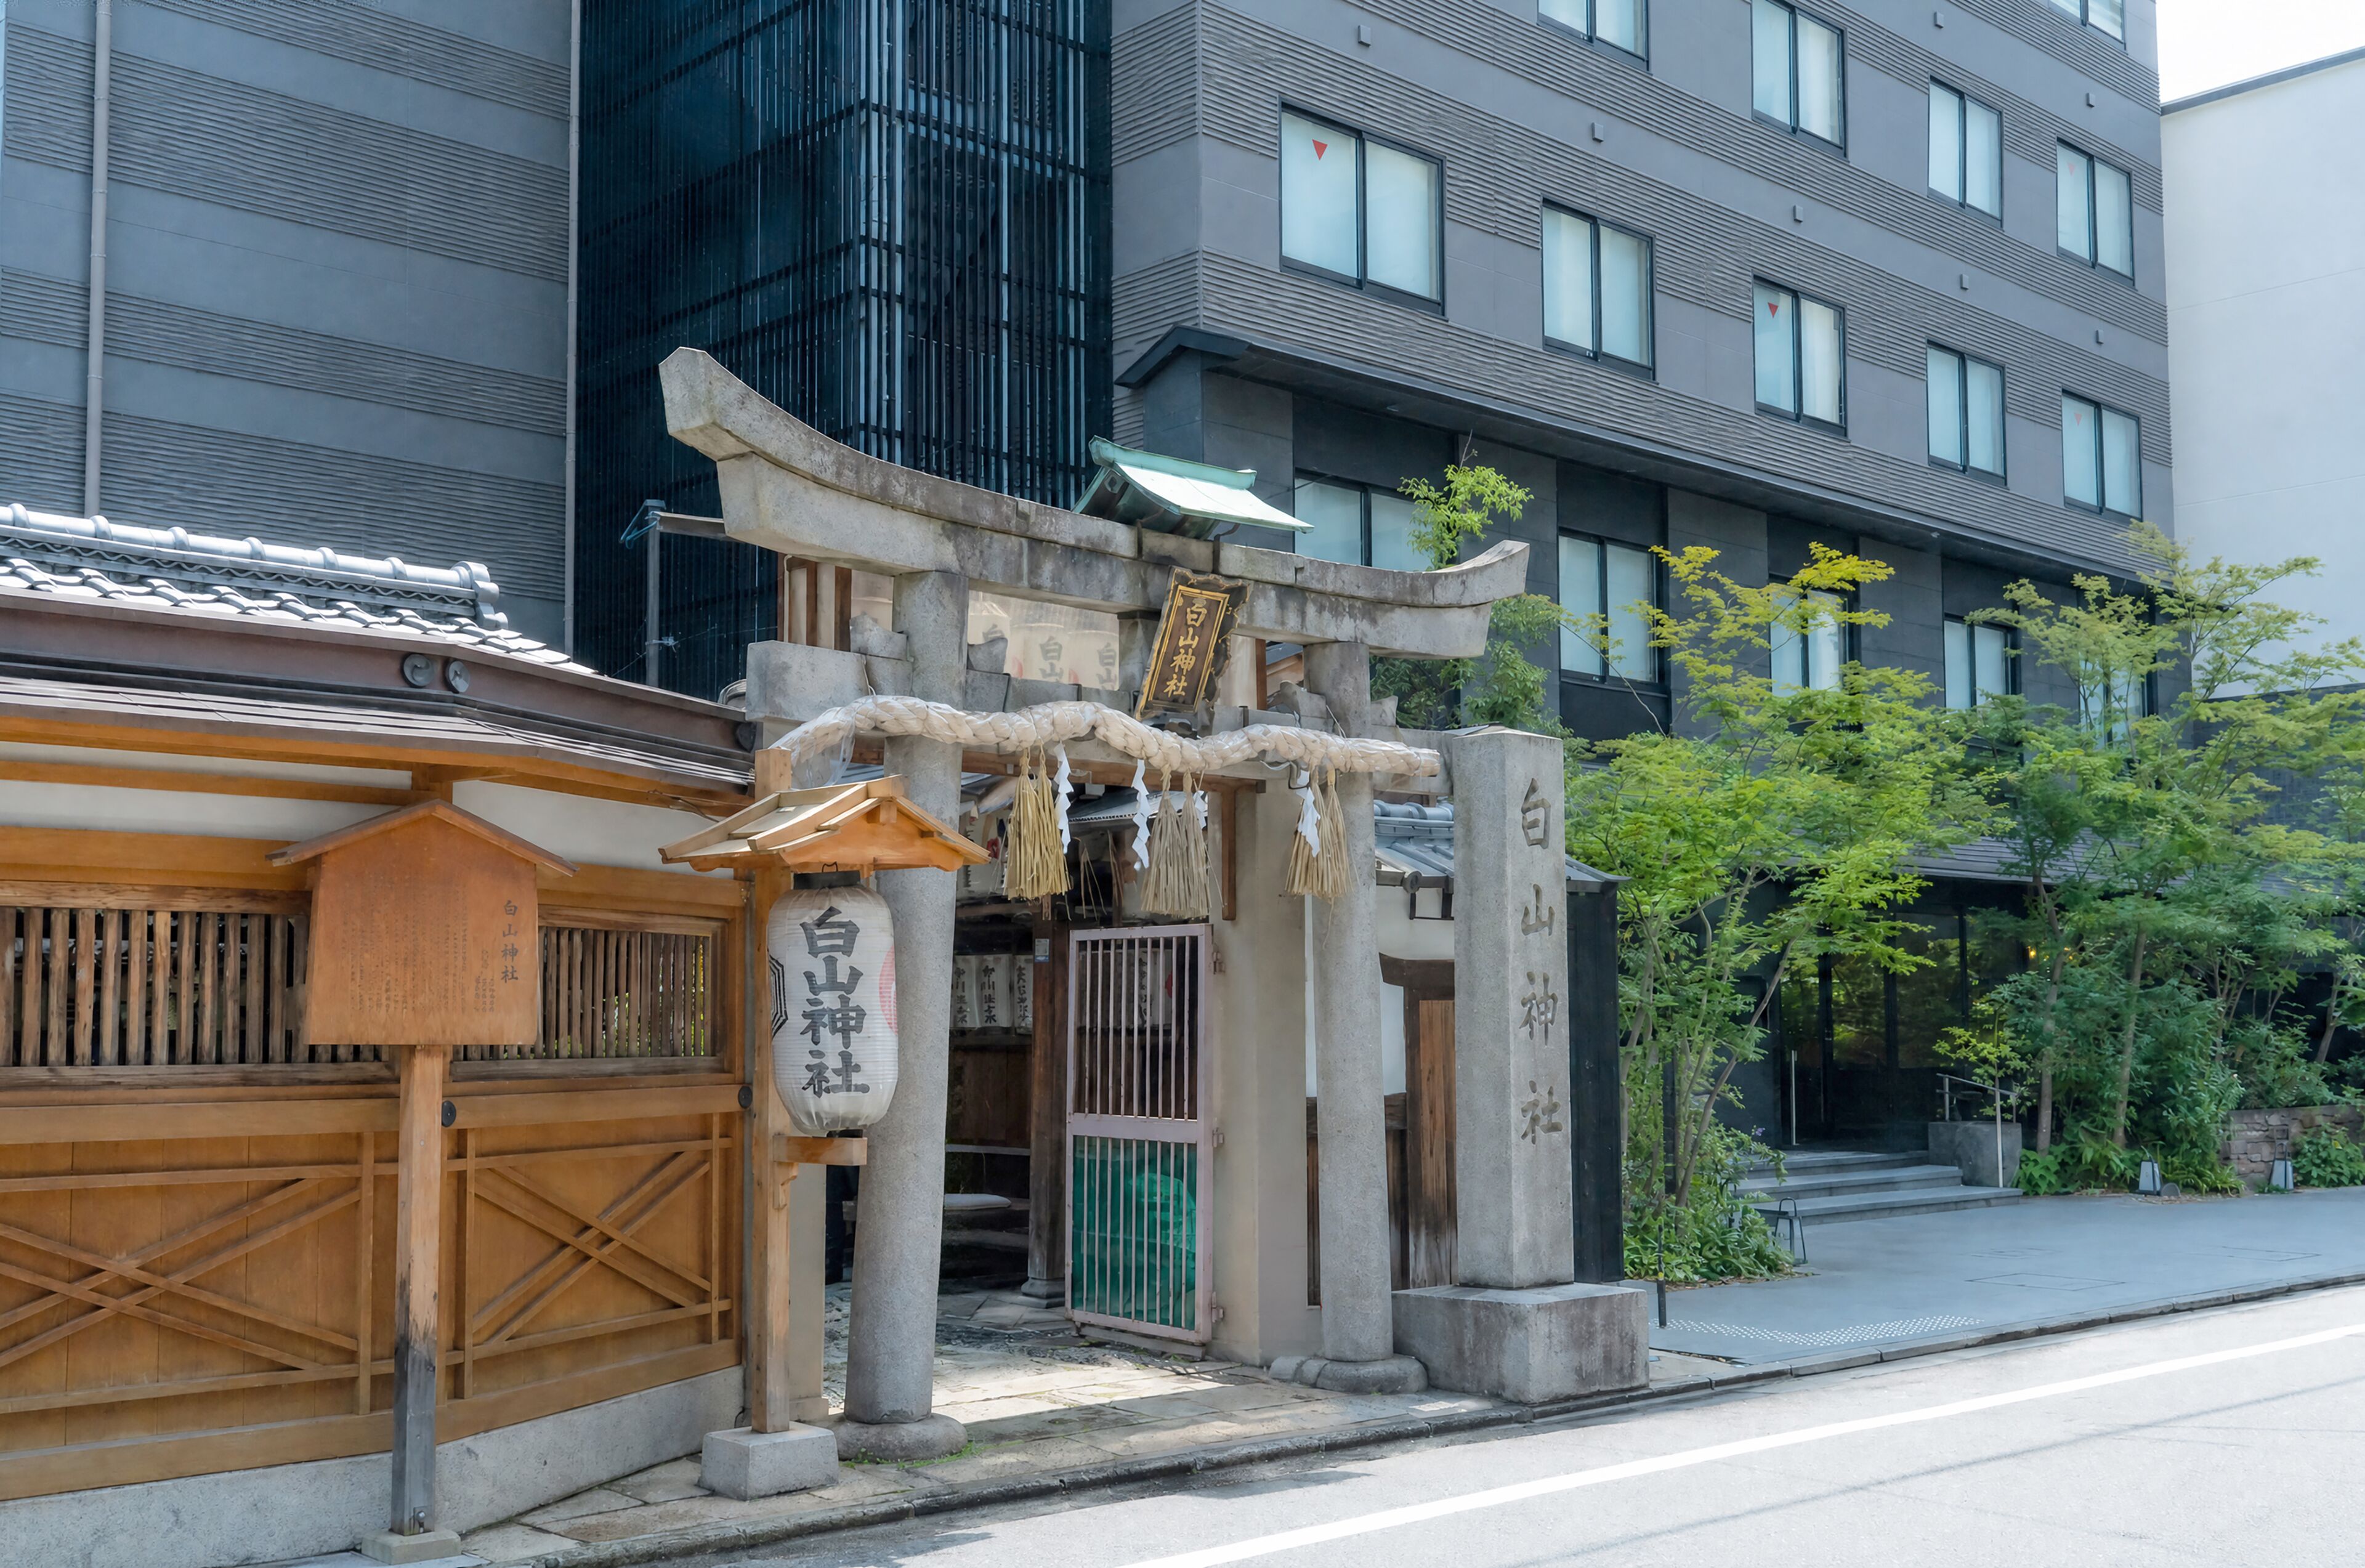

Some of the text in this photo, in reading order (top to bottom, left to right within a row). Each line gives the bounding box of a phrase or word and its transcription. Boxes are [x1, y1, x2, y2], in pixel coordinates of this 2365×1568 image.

[1038, 636, 1064, 683] 白山
[1096, 642, 1117, 690] 白山
[1163, 597, 1207, 698] 白山神社
[501, 900, 519, 984] 白山神社
[1519, 778, 1563, 1144] 白山神社
[800, 906, 870, 1098] 白山神社
